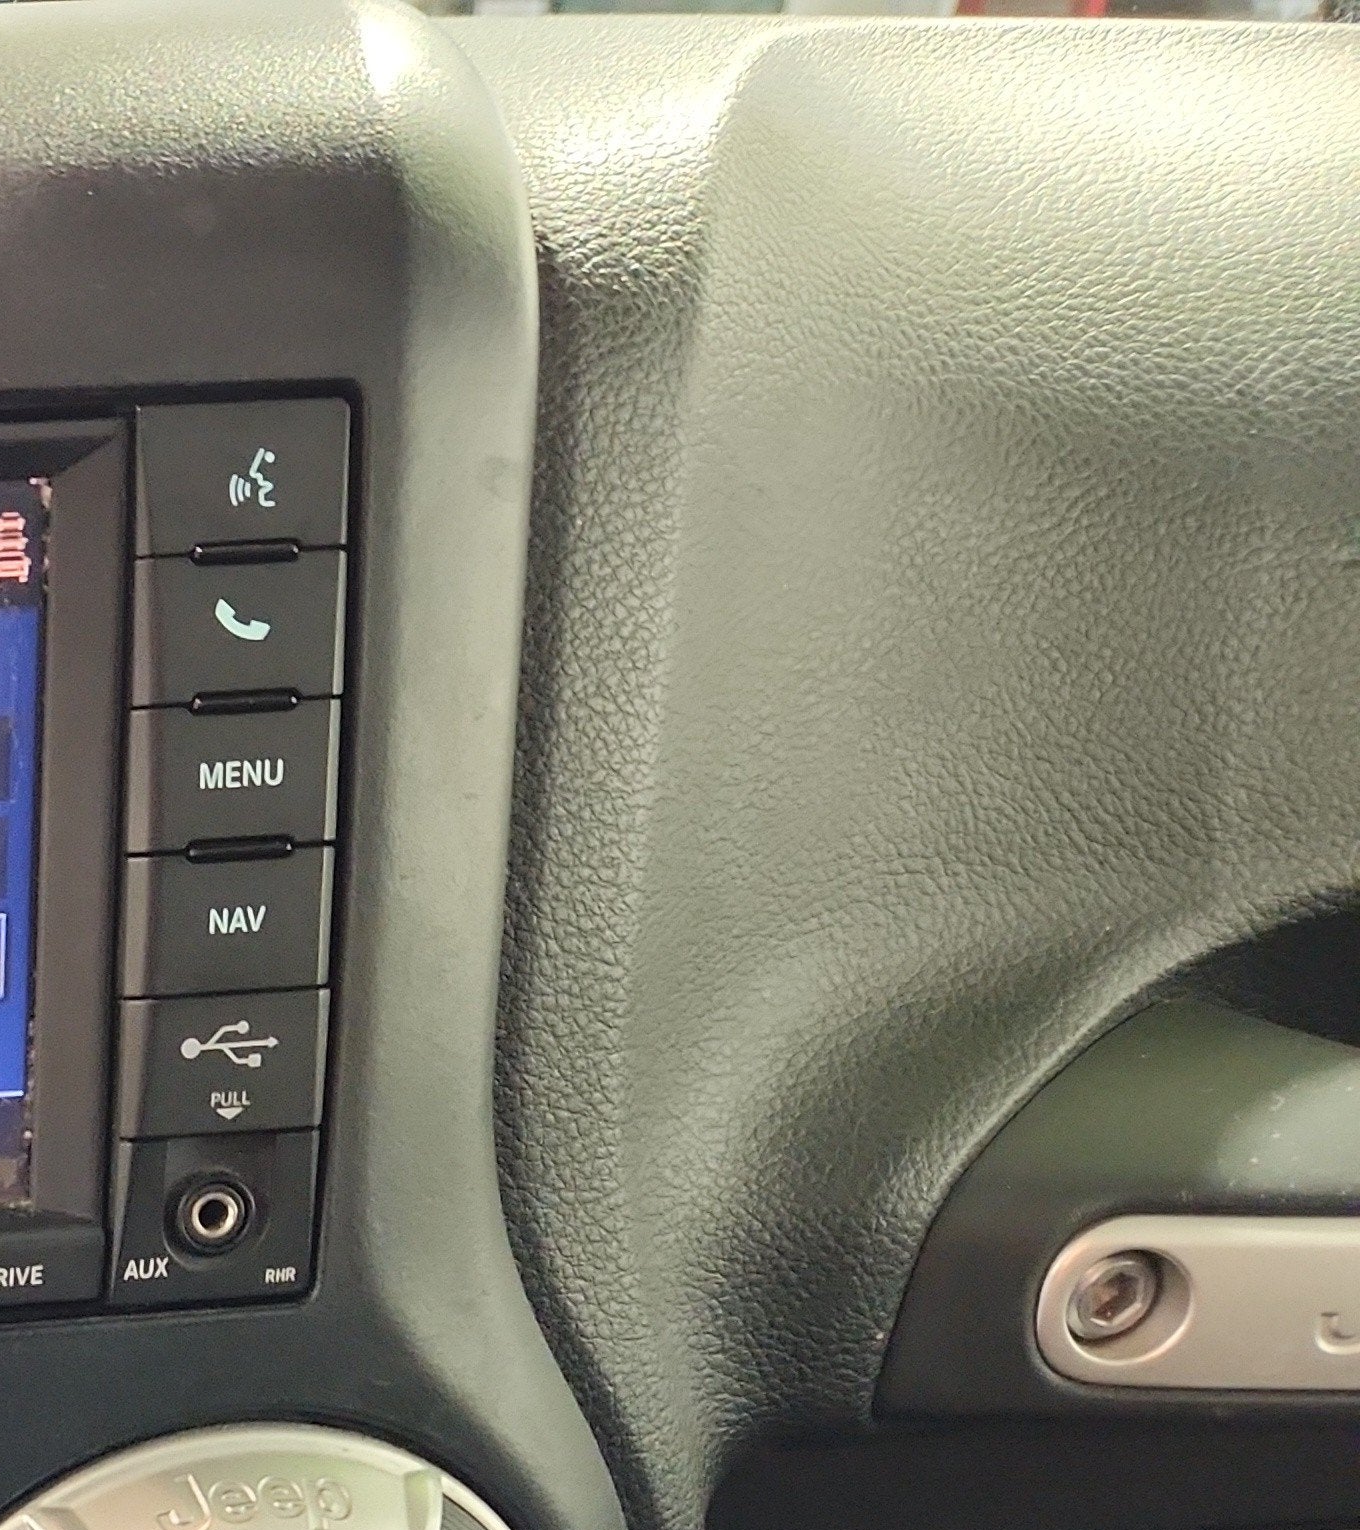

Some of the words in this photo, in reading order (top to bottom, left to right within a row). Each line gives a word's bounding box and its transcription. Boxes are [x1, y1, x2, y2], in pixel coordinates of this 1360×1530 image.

[198, 758, 285, 790] MENU
[208, 904, 267, 936] NAV
[209, 1089, 251, 1109] PULL
[122, 1256, 169, 1281] AUX
[264, 1265, 297, 1285] RHR
